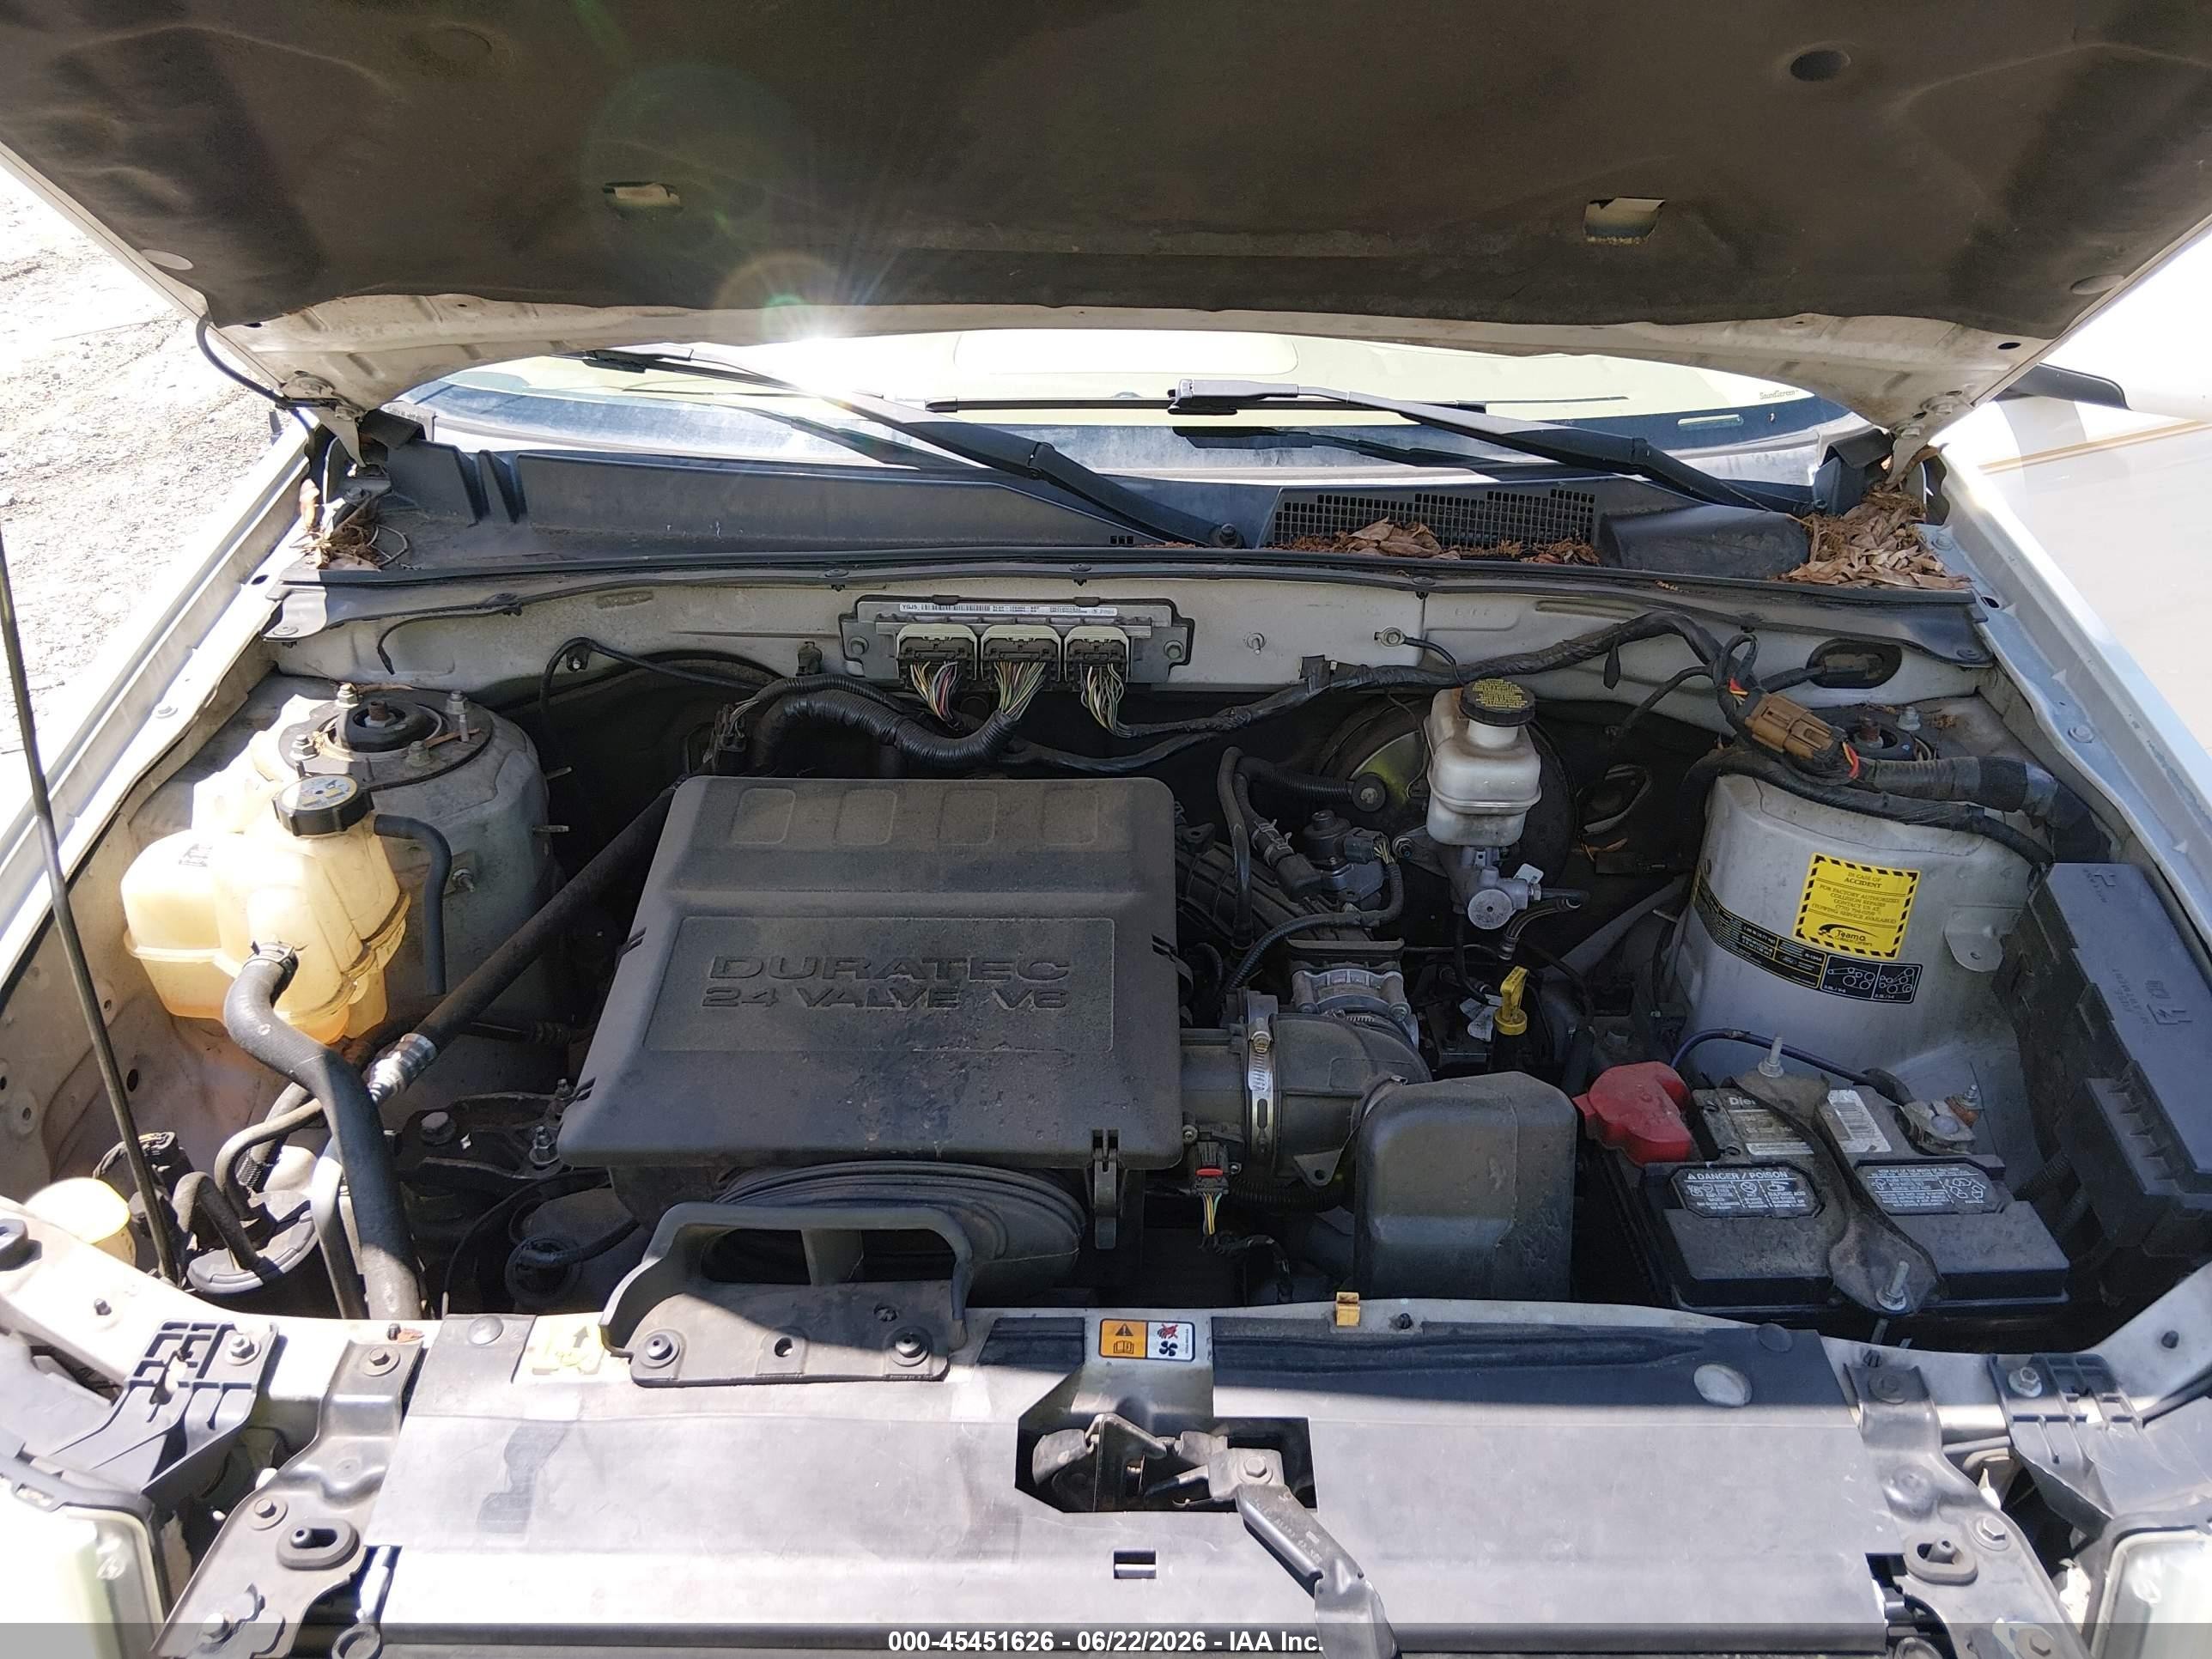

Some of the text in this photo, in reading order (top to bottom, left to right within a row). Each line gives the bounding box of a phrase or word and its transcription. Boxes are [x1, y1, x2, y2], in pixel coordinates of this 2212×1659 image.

[1844, 878, 1882, 888] ACCIDENT
[709, 955, 1072, 982] DURATEC
[702, 986, 1067, 1011] 24 VALVE V6
